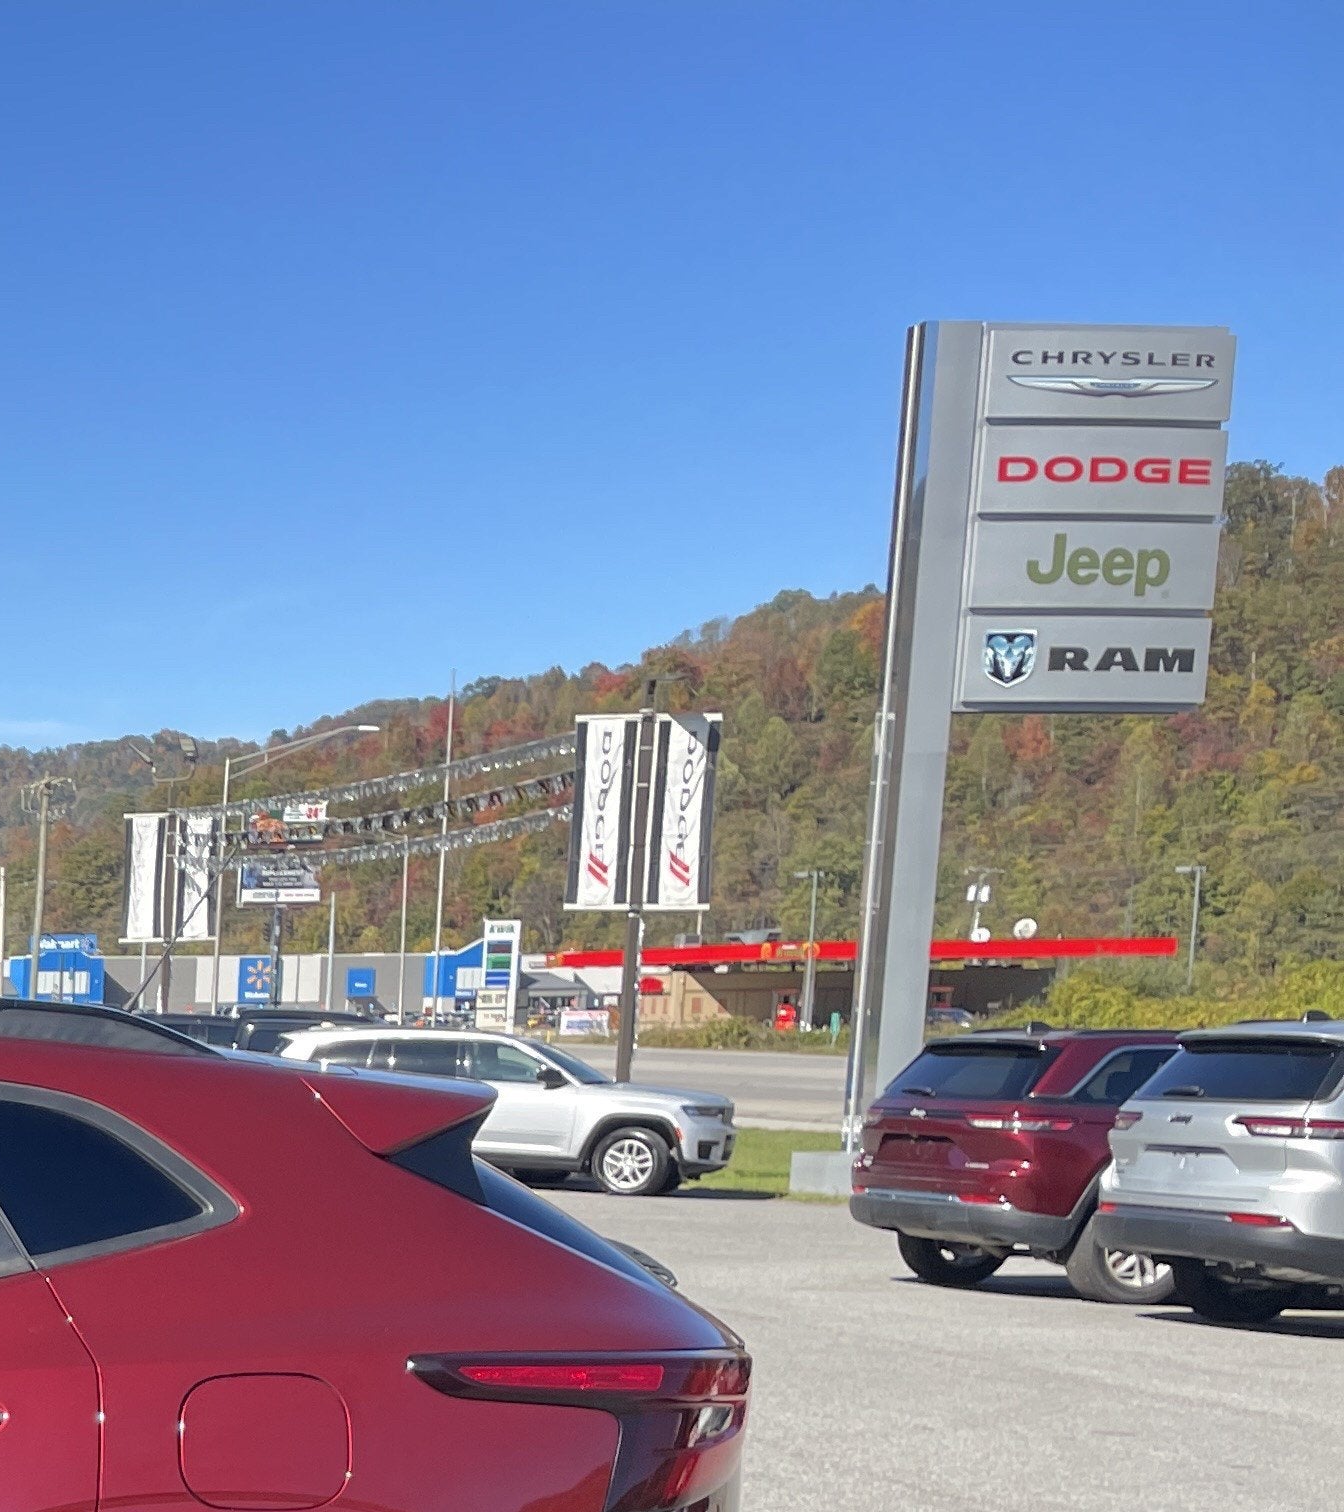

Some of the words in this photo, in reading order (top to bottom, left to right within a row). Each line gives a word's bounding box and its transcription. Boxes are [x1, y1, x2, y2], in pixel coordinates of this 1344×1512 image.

[1011, 349, 1216, 369] CHRYSLER
[997, 455, 1212, 485] DODGE
[1026, 532, 1171, 597] Jeep
[1047, 646, 1195, 673] RAM
[594, 730, 613, 867] DODGE
[675, 730, 698, 867] DODGE
